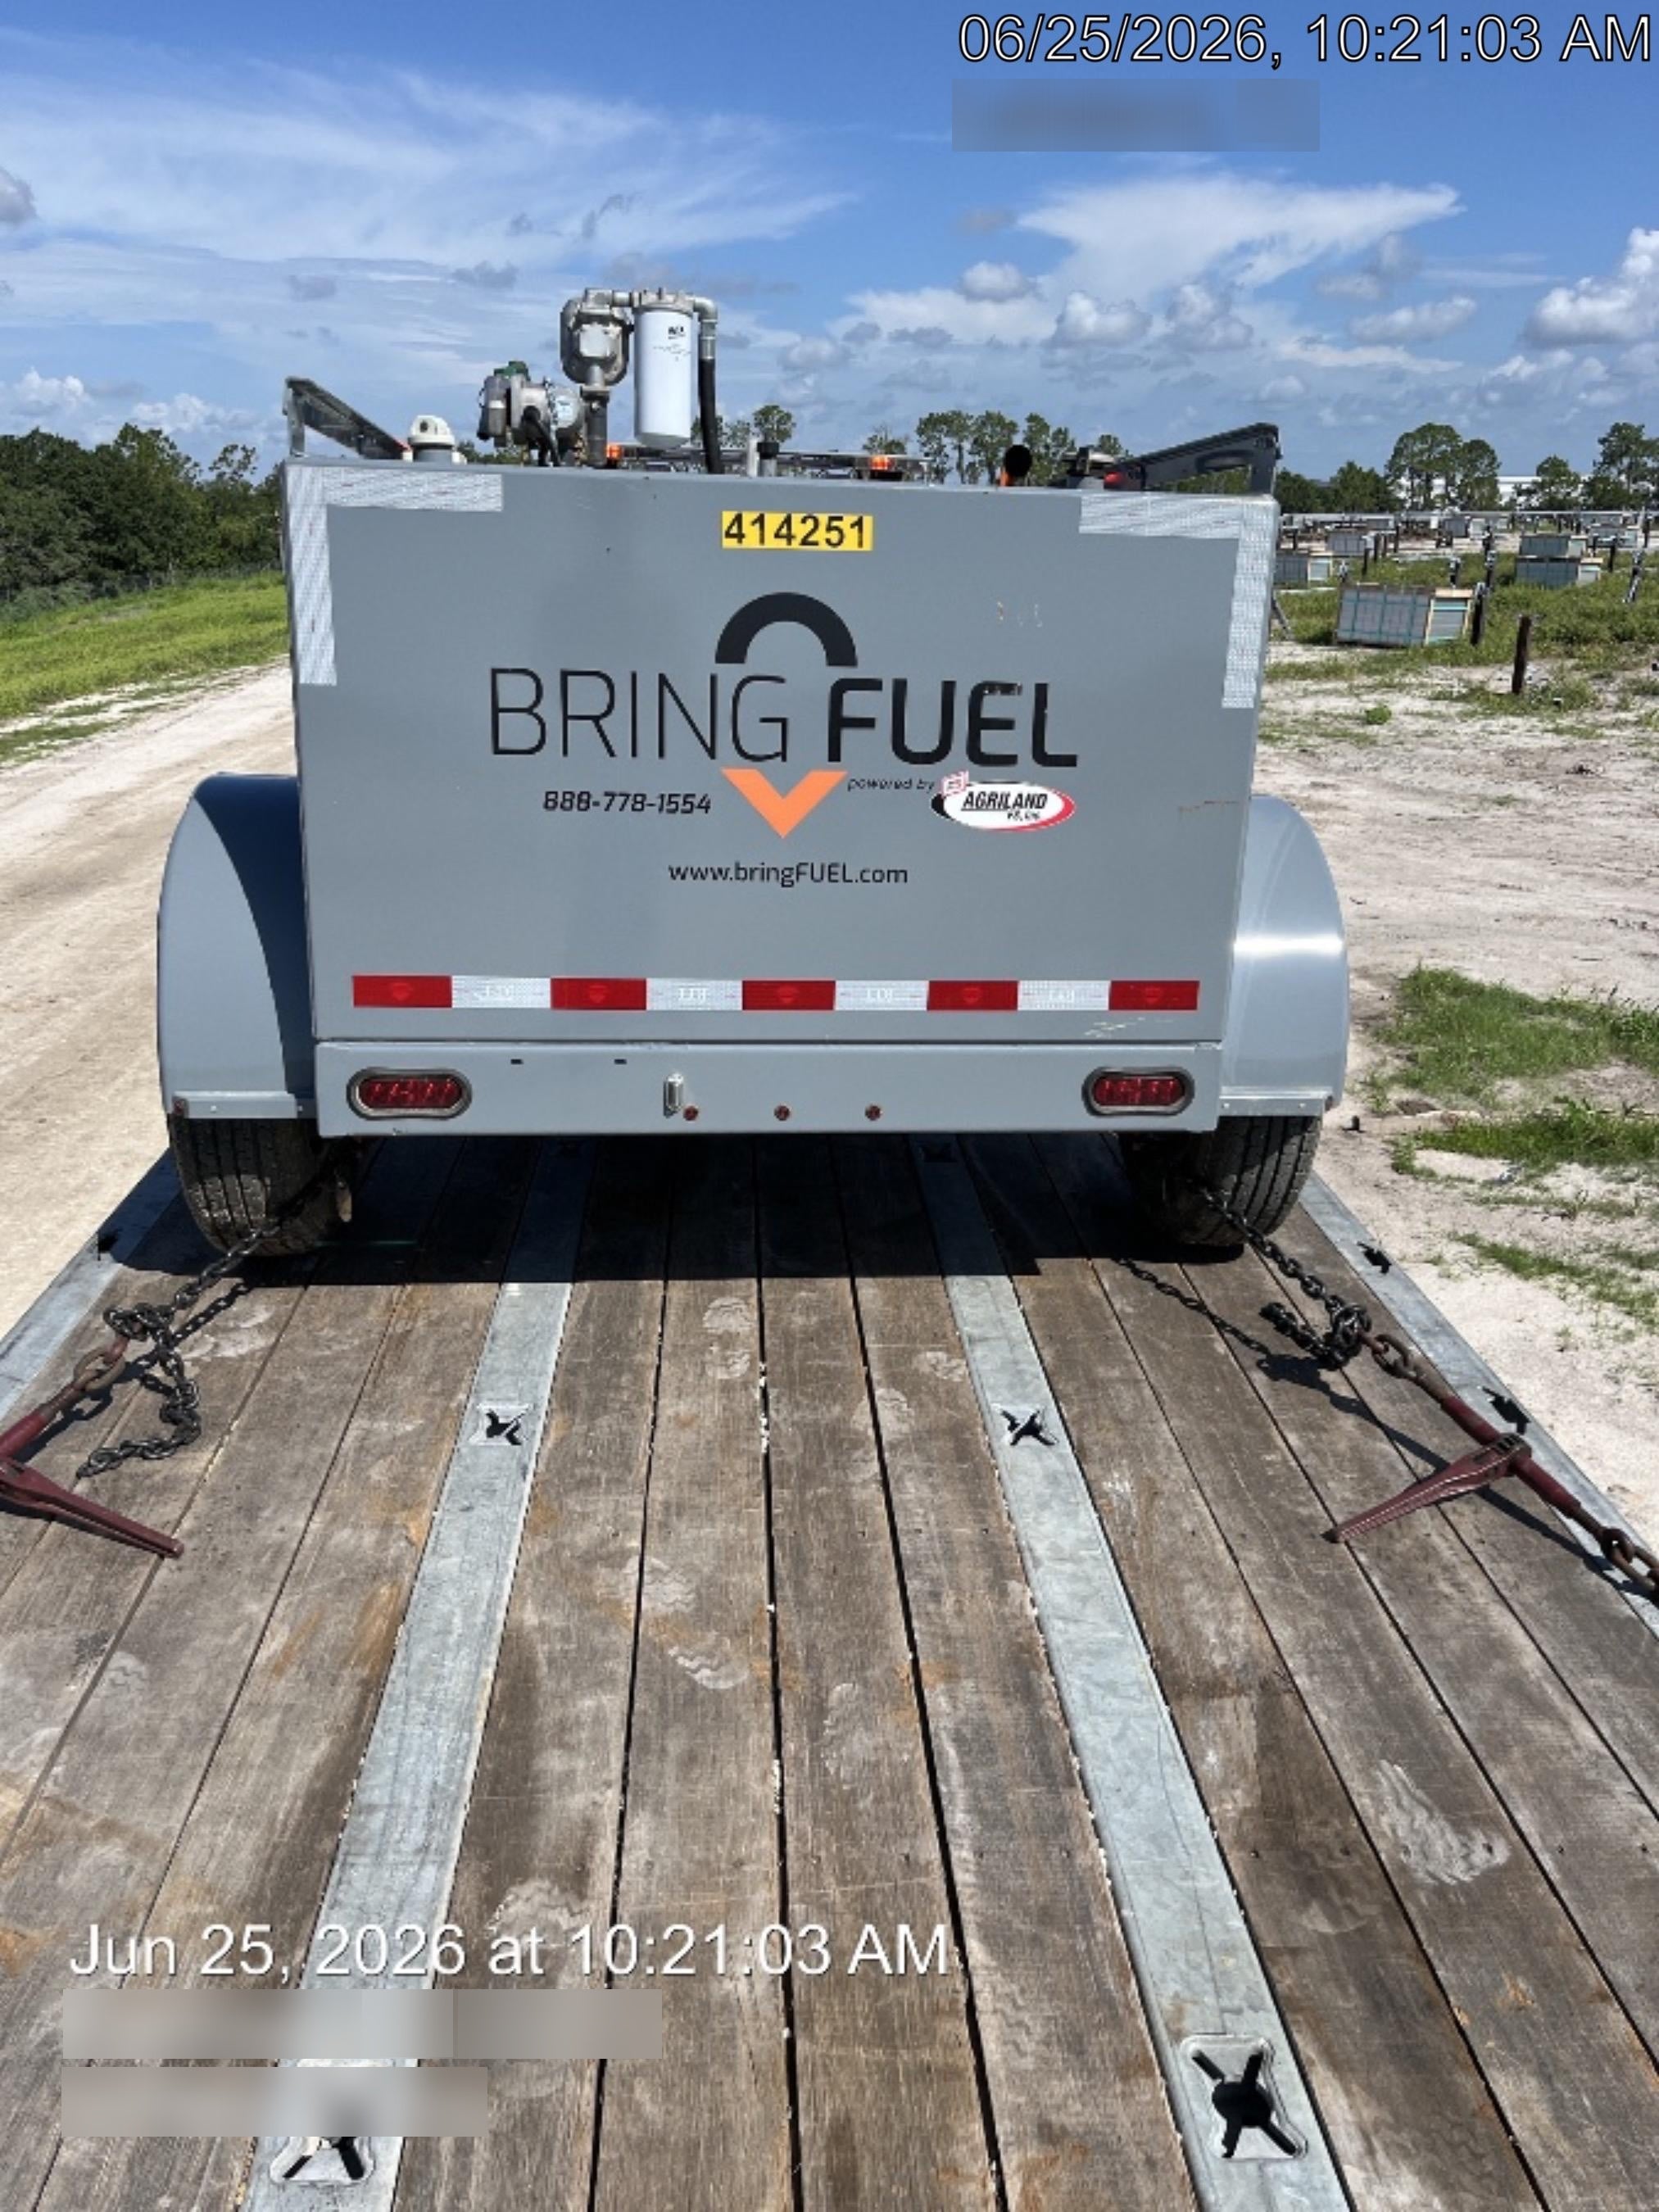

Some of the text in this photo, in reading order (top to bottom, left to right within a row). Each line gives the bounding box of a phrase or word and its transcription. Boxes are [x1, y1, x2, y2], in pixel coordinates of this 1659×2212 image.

[724, 513, 865, 548] 414251
[490, 667, 1078, 768] BRING FUEL
[847, 777, 913, 793] powered
[916, 777, 935, 795] by
[542, 791, 711, 814] 888-778-1554
[963, 791, 1048, 809] AGRILAND
[668, 862, 909, 888] www.bringFUEL.com
